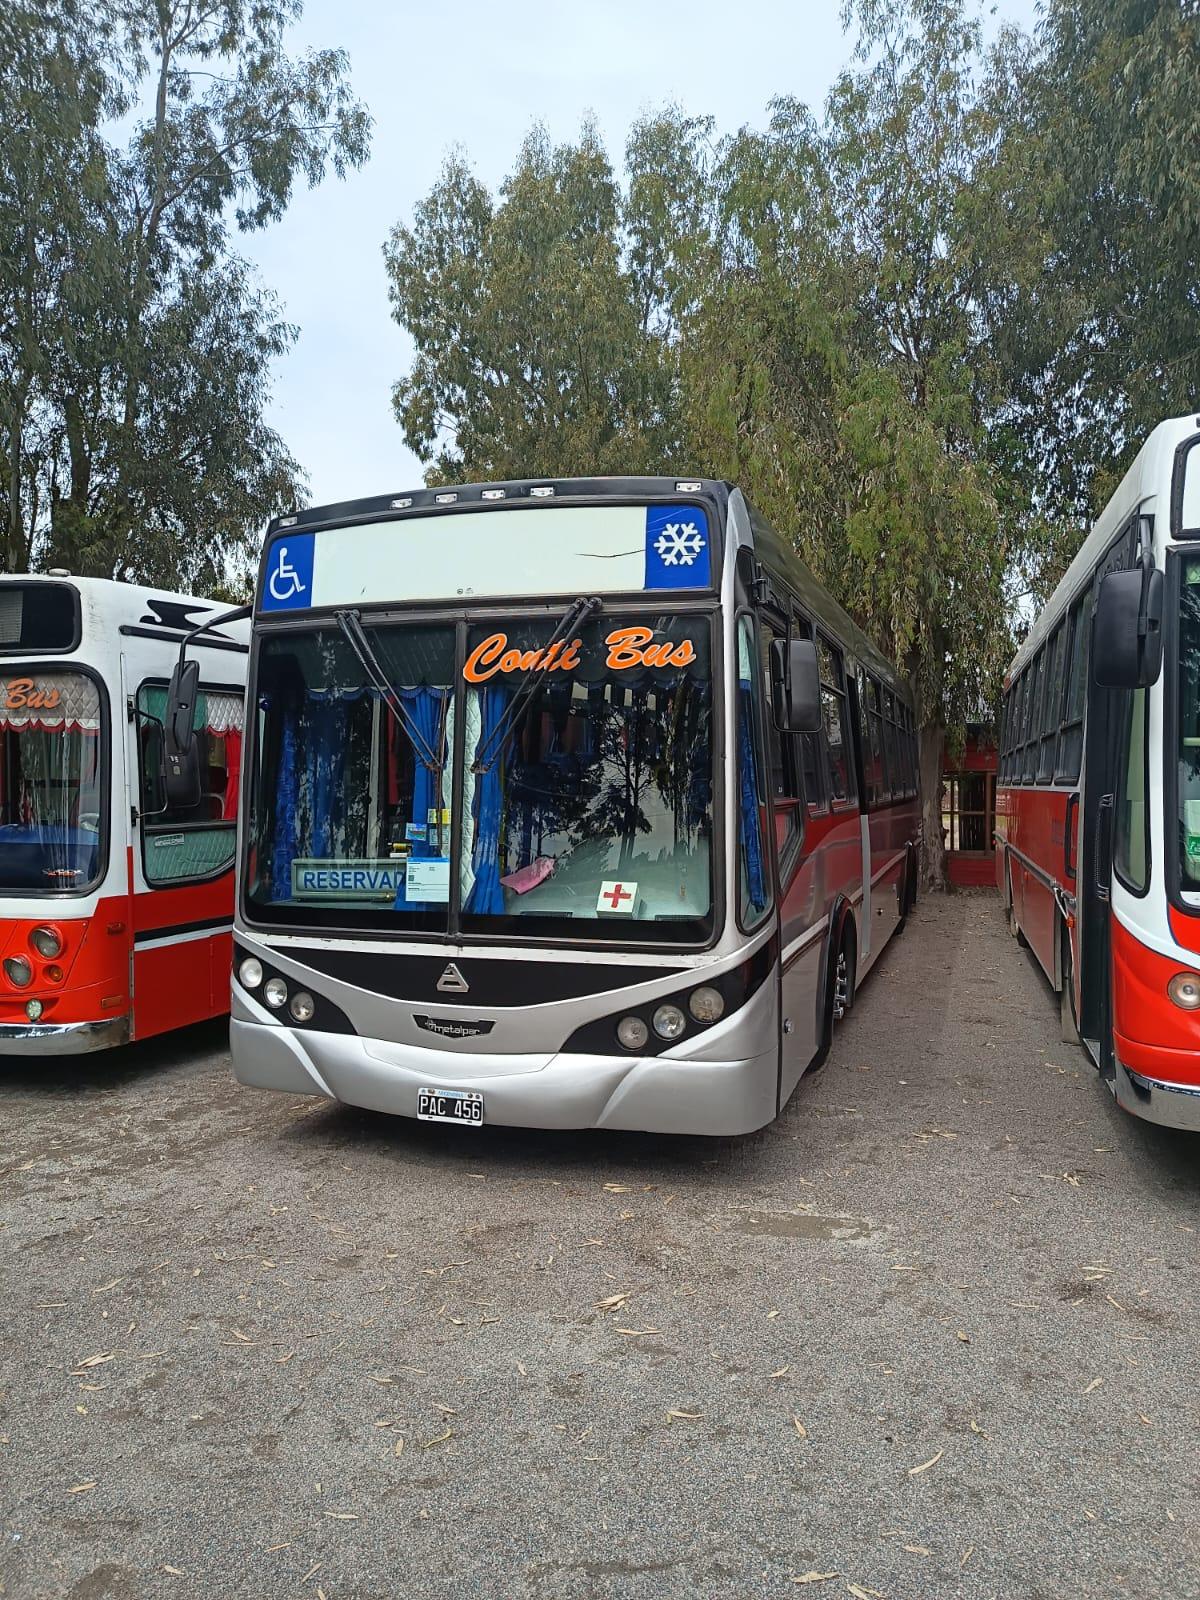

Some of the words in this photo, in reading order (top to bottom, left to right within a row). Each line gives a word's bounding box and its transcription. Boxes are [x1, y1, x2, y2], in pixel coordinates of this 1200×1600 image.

[605, 626, 697, 670] Bus
[6, 678, 61, 708] Bus
[303, 871, 406, 889] RESERVAD
[430, 1023, 480, 1036] metalpar
[420, 1095, 446, 1115] PAC
[454, 1100, 480, 1119] 456
